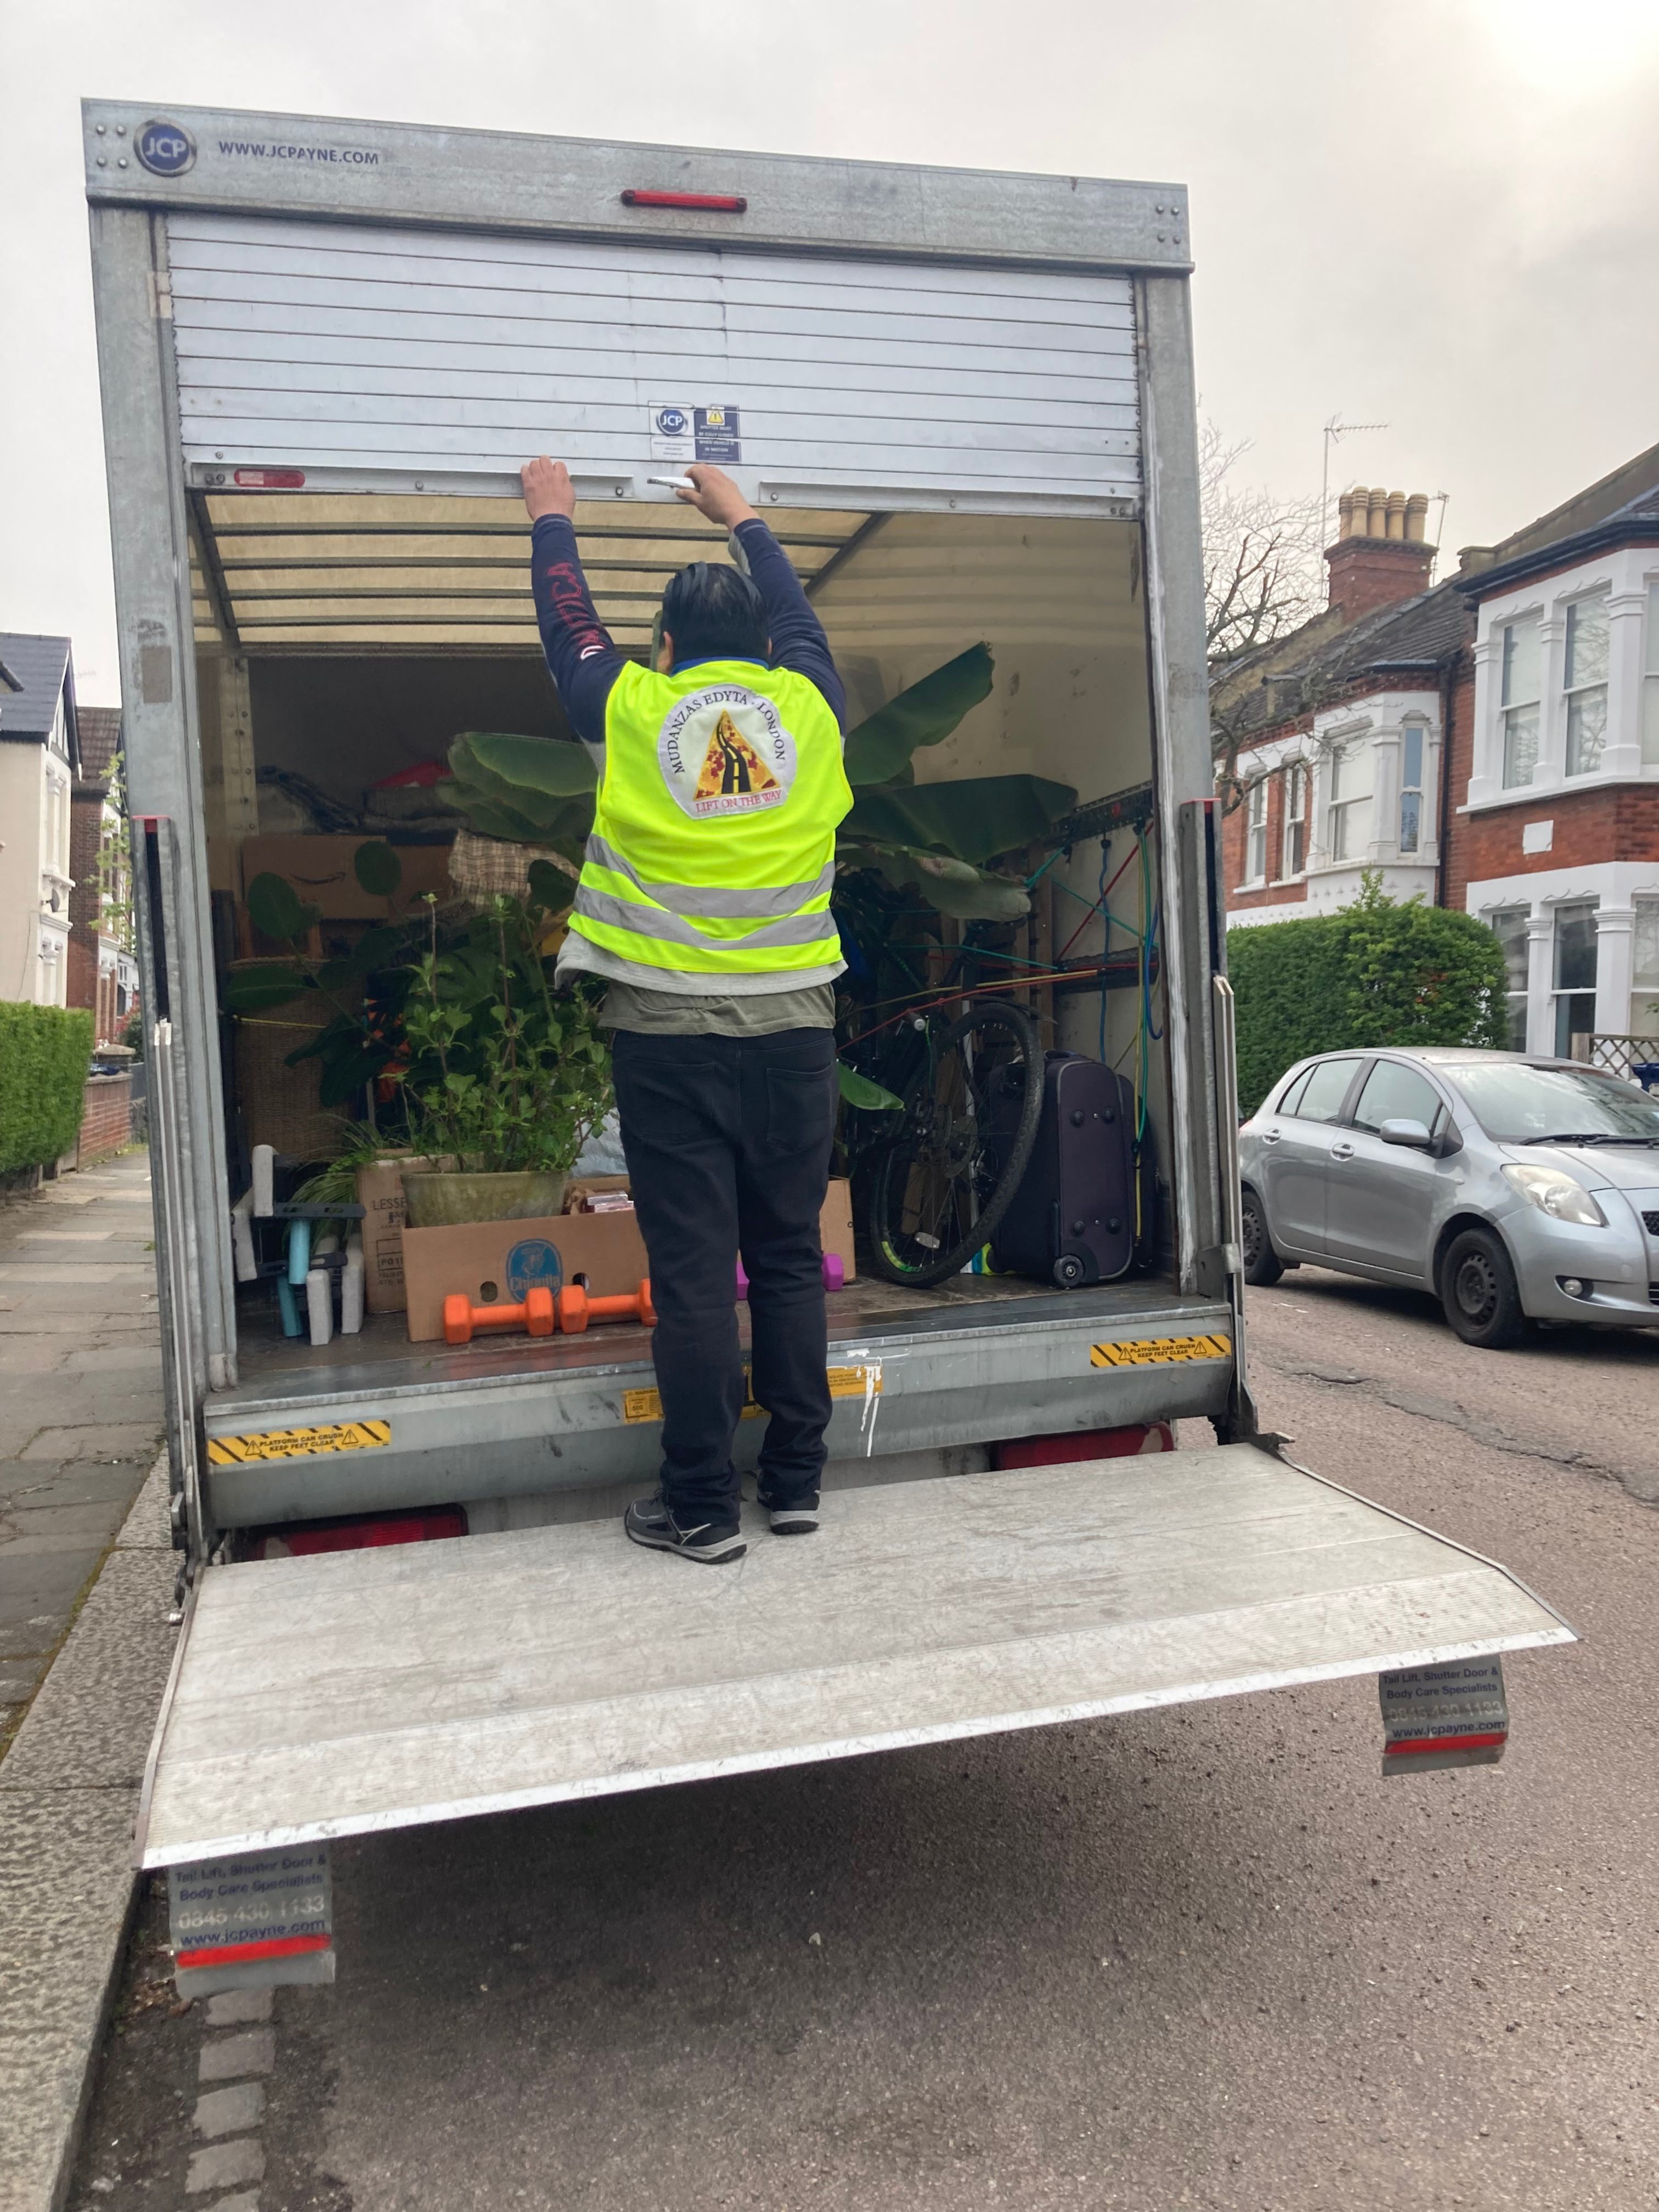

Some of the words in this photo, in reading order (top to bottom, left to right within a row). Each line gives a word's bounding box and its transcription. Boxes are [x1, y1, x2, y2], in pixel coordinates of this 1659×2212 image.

[146, 136, 185, 157] JCP
[219, 141, 379, 165] WWW.JCPAYNE.COM
[662, 415, 682, 426] JCP
[667, 699, 702, 774] MUDANZAS
[704, 691, 748, 705] EDYTA
[757, 702, 785, 760] LONDON
[696, 800, 719, 812] LIFT
[721, 798, 737, 809] ON
[739, 795, 761, 807] THE
[763, 790, 782, 804] WAY
[259, 1437, 299, 1447] PLATFORM
[318, 1432, 343, 1441] CRUSH
[269, 1444, 289, 1452] KEEP
[311, 1439, 335, 1447] CLEAR
[1384, 1674, 1399, 1684] Tail
[1424, 1669, 1460, 1681] Shutter
[1464, 1668, 1488, 1678] Door
[1491, 1667, 1499, 1675] &
[1387, 1689, 1413, 1700] Body
[1415, 1687, 1440, 1697] Care
[1442, 1683, 1498, 1695] Specialists
[1392, 1721, 1505, 1738] www.jcpayne.com
[179, 1887, 213, 1901] Body
[252, 1872, 324, 1892] Specialists
[180, 1920, 325, 1946] www.jcpayne.com
